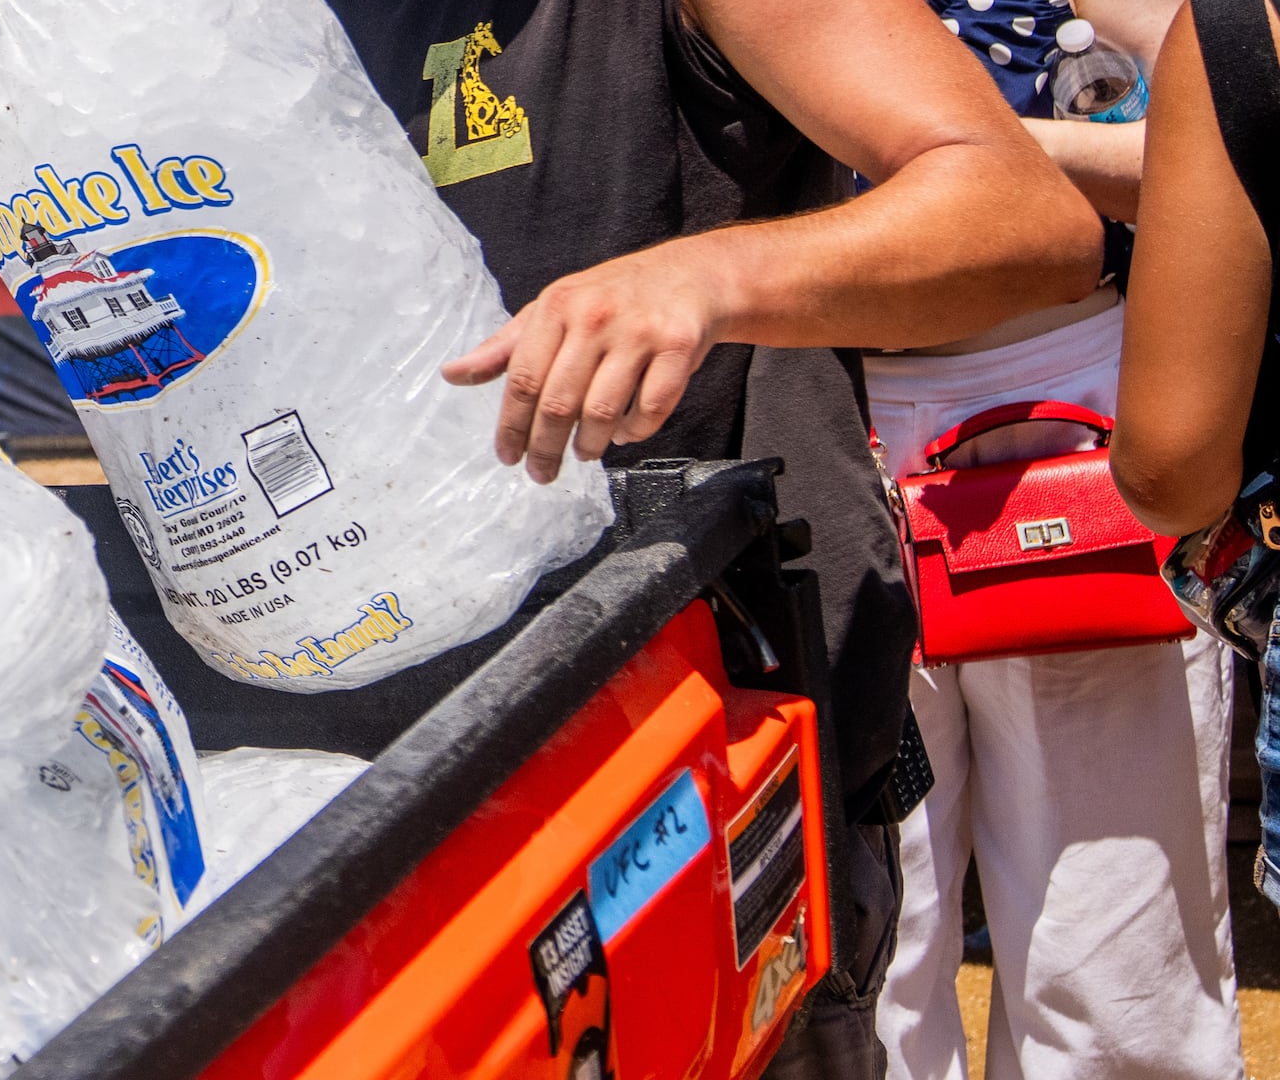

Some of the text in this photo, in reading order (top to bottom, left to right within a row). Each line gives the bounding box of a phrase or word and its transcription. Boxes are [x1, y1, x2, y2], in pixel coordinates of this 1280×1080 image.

[111, 144, 234, 216] Ice
[206, 588, 228, 606] 20
[226, 572, 267, 598] LBS
[270, 542, 322, 583] (9.07
[327, 521, 368, 551] kg)
[218, 594, 295, 625] MADE IN USA
[296, 592, 414, 668] Enough?
[602, 804, 689, 900] UFC #2
[553, 907, 590, 957] ASSET
